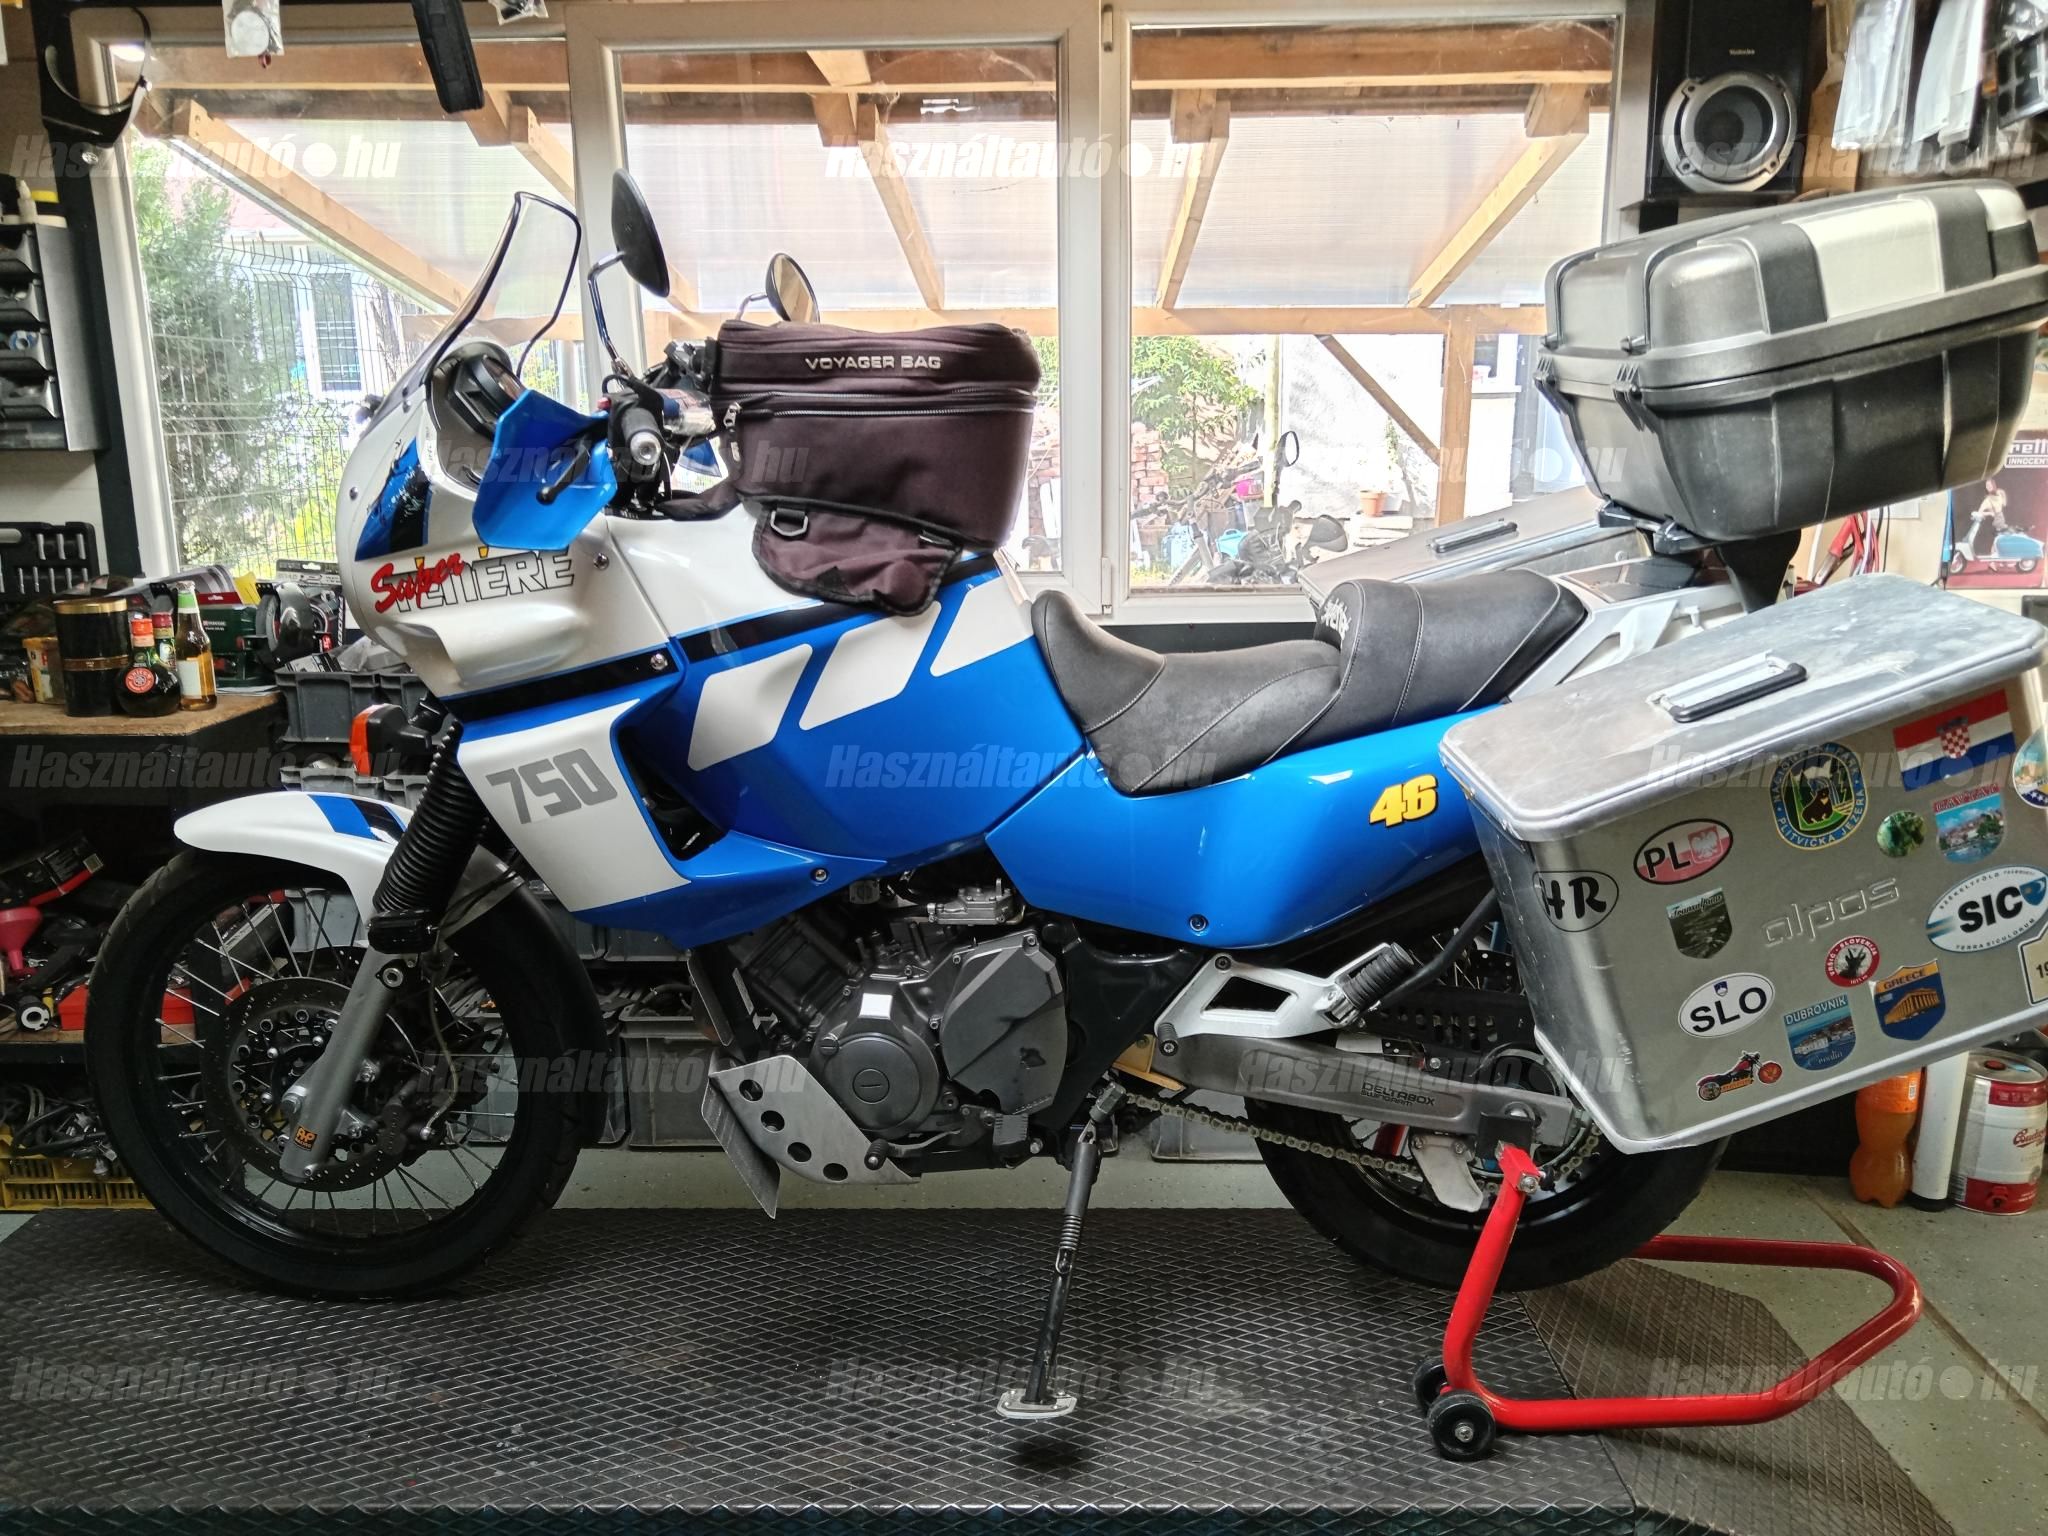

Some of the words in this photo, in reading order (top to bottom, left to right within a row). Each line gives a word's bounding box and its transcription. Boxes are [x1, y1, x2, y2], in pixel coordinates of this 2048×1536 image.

[804, 355, 895, 370] VOYAGER
[900, 355, 942, 369] BAG
[371, 552, 465, 613] Super
[485, 748, 618, 824] 750
[1369, 774, 1438, 827] 46
[1643, 841, 1691, 879] PL
[1539, 876, 1608, 920] HR
[1762, 876, 1900, 948] alpos
[1957, 885, 2024, 934] SIC
[1883, 968, 1925, 990] GREECE
[1690, 986, 1768, 1033] SLO
[1785, 995, 1848, 1026] DUBROVNIK
[1361, 1081, 1436, 1106] DELTABOX
